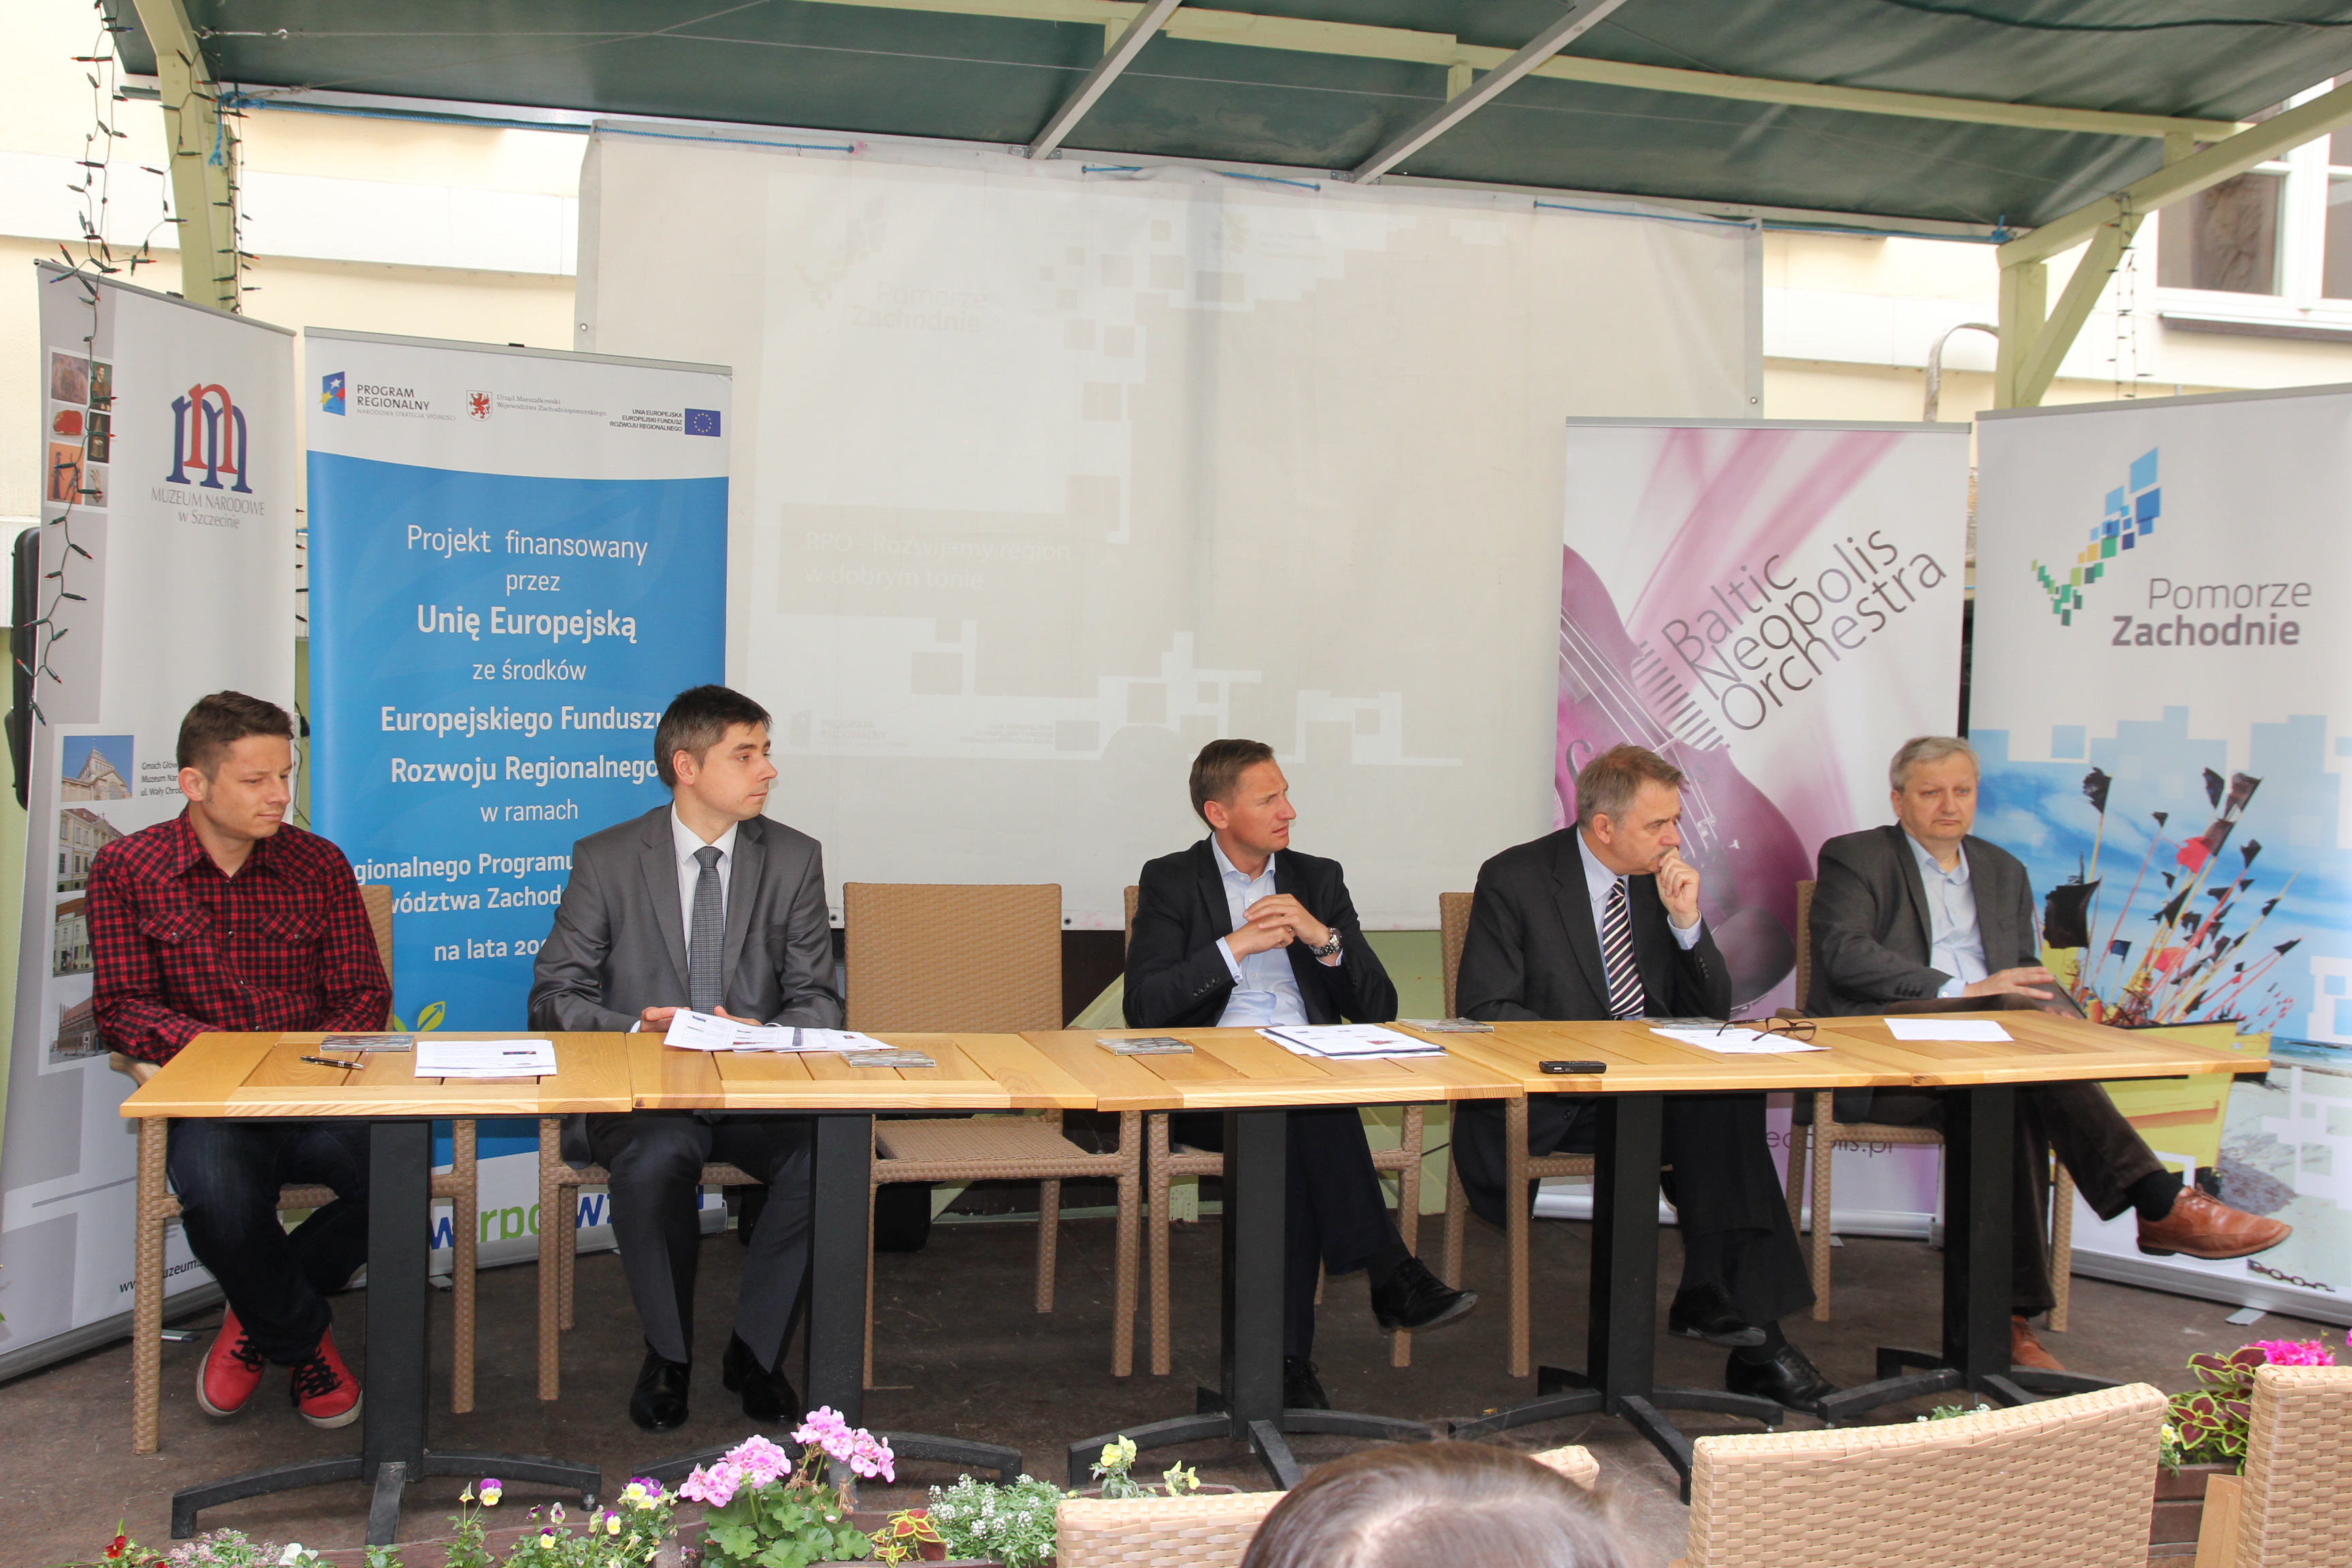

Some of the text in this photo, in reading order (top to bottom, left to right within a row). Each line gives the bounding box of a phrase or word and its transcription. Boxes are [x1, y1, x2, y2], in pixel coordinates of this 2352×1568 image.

[877, 281, 987, 310] Pomorze
[851, 304, 981, 333] Zachodnie
[357, 384, 414, 398] PROGRAM
[357, 396, 430, 410] REGIONALNY
[357, 408, 394, 416] NARODOWA
[538, 405, 606, 416] Zachodniopomorskiego
[647, 410, 683, 418] EUROPEJSKA
[640, 423, 683, 431] REGIONALNEGO
[151, 487, 265, 516] MUZEUM NARODOWE
[178, 510, 240, 529] w Szczecinie
[408, 525, 648, 566] Projekt finansowany
[873, 534, 994, 562] Rozwijamy
[1000, 541, 1071, 564] region
[506, 574, 560, 596] przez
[804, 564, 983, 591] w dobrym tonie
[2149, 578, 2311, 610] Pomorze
[1661, 554, 1797, 665] Baltic
[1690, 529, 1898, 701] Neopolis
[417, 604, 637, 644] Unię Europejską
[2112, 612, 2300, 646] Zachodnie
[1721, 553, 1946, 730] Orchestra
[473, 658, 587, 681] ze środków
[381, 706, 553, 738] Europejskiego
[142, 761, 178, 770] Gmach Głów
[391, 755, 659, 788] Rozwoju Regionalnego
[480, 799, 578, 822] w ramach
[354, 856, 471, 885] gionalnego
[487, 884, 565, 909] Zachod
[434, 946, 459, 962] na
[468, 938, 507, 959] lata
